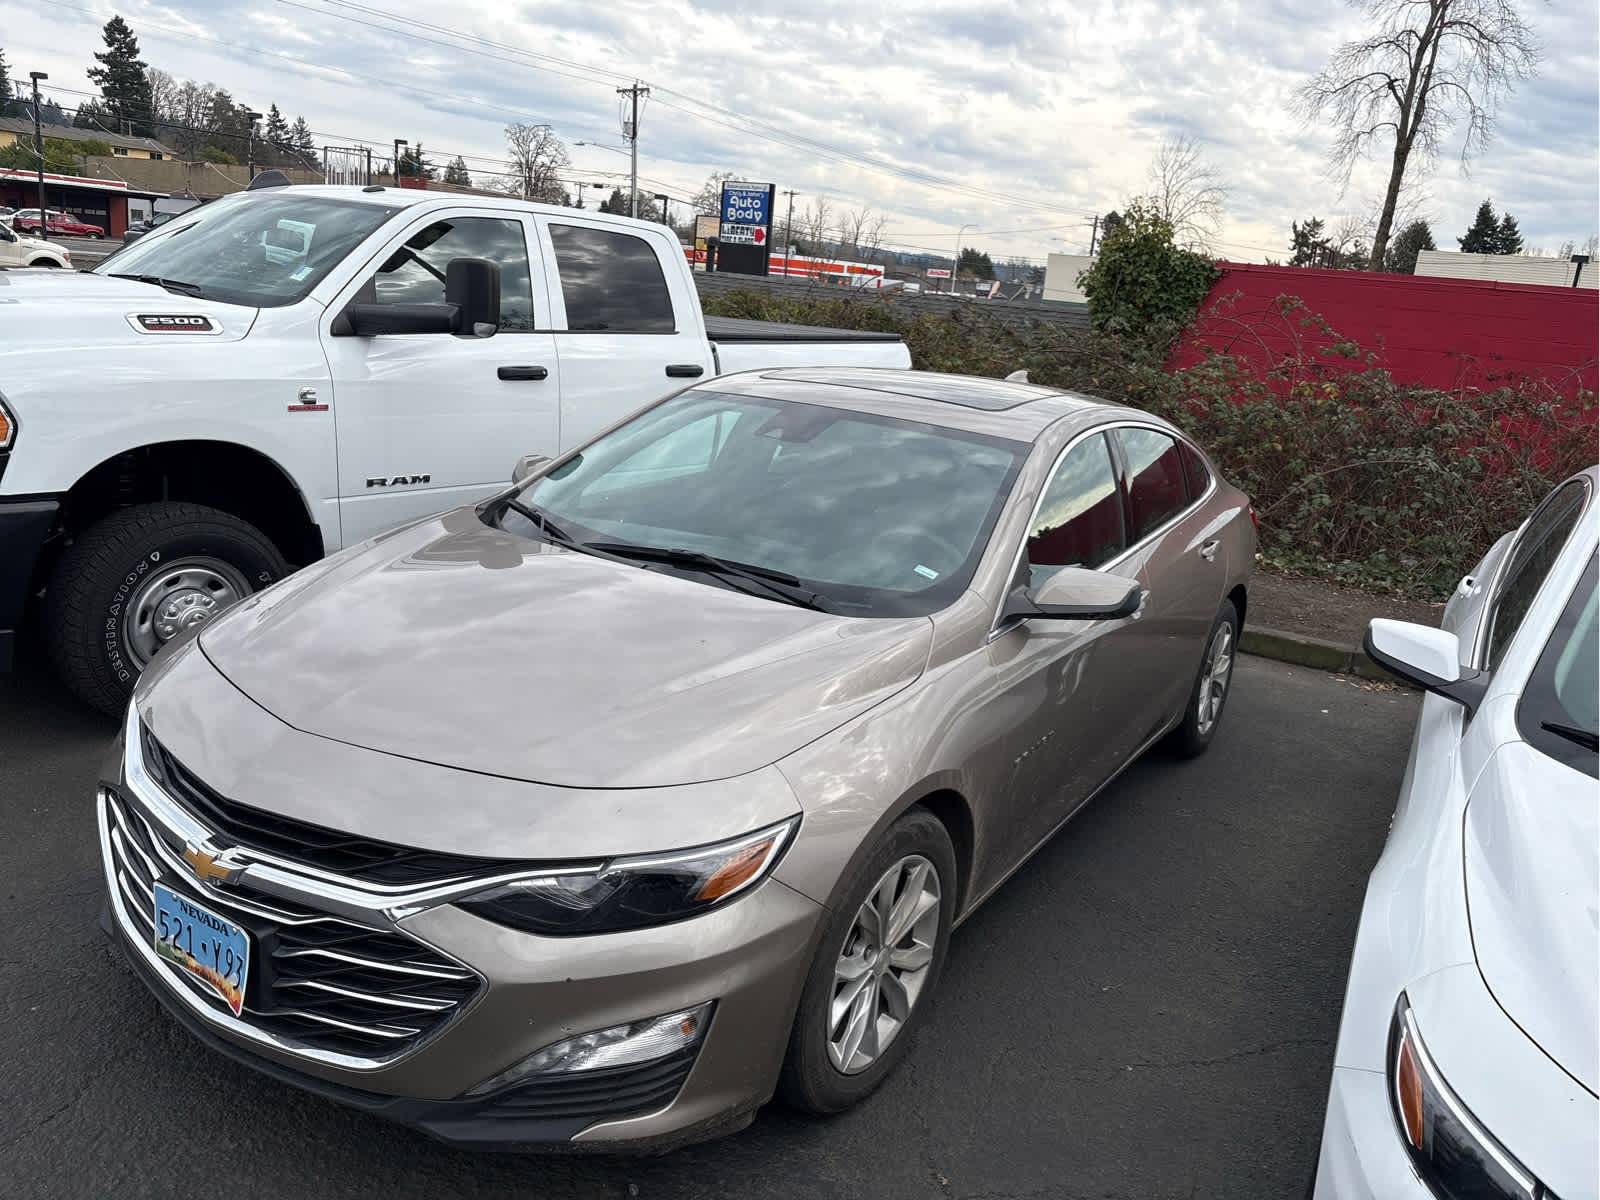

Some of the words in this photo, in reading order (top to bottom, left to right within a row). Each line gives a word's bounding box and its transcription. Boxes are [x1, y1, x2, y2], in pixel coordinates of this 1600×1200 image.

[730, 196, 761, 209] Auto
[727, 208, 763, 222] Body
[144, 317, 204, 325] 2500
[366, 473, 431, 488] RAM
[105, 560, 149, 682] DESTINATION
[179, 900, 229, 937] NEVADA
